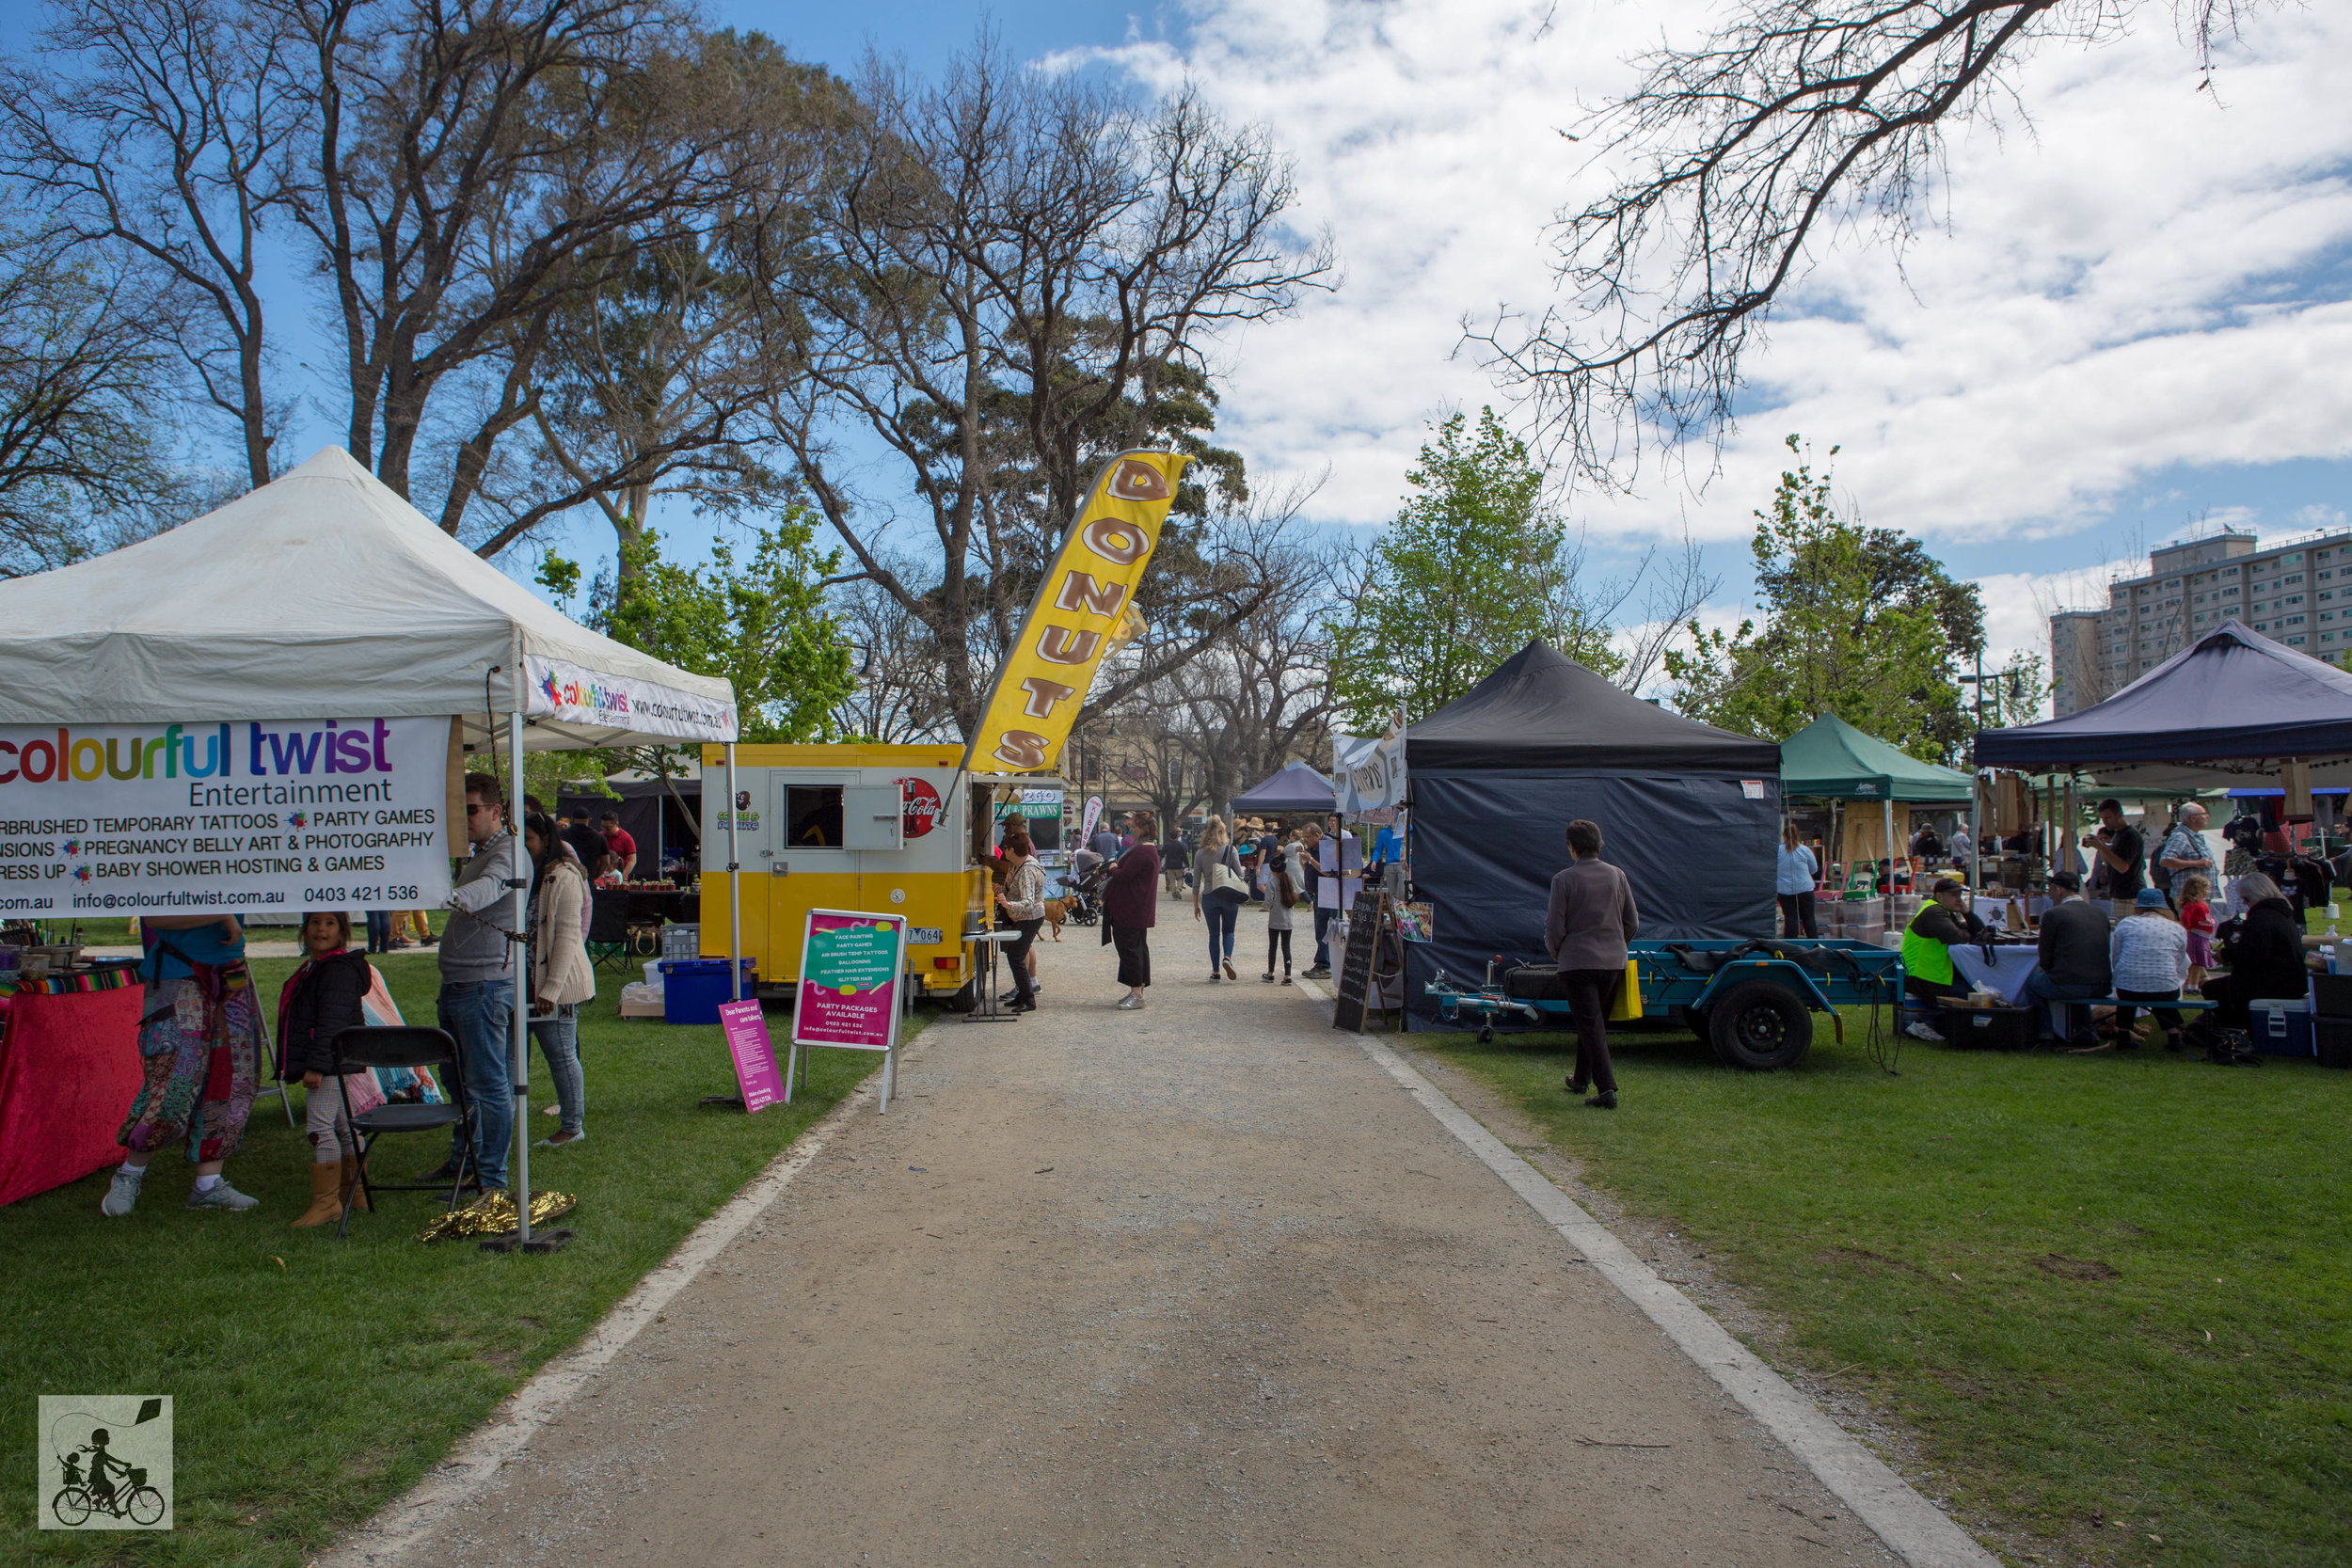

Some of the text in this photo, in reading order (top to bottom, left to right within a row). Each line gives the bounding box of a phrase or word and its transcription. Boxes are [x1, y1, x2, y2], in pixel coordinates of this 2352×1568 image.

[993, 459, 1170, 768] DONUTS
[0, 718, 392, 784] colourful twist
[190, 779, 392, 807] Entertainment
[93, 816, 196, 833] TEMPORARY
[199, 813, 279, 831] TATTOOS
[313, 811, 370, 828] PARTY
[374, 809, 436, 825] GAMES
[1022, 804, 1057, 817] PRAWNS
[1081, 805, 1097, 847] KEBABS
[85, 838, 188, 856] PREGNANCY
[193, 836, 245, 853] BELLY
[248, 835, 282, 851] ART
[287, 835, 300, 850] &
[305, 832, 435, 848] PHOTOGRAPHY
[44, 863, 67, 879] UP
[96, 862, 142, 878] BABY
[147, 860, 222, 876] SHOWER
[226, 857, 302, 874] HOSTING
[307, 857, 319, 872] &
[325, 855, 385, 871] GAMES
[72, 890, 285, 909] info@colourfultwist.com.au
[304, 887, 346, 902] 0403
[352, 886, 381, 901] 421
[388, 885, 419, 900] 536
[817, 1002, 878, 1013] PARTY PACKAGES
[826, 1010, 866, 1020] AVAILABLE
